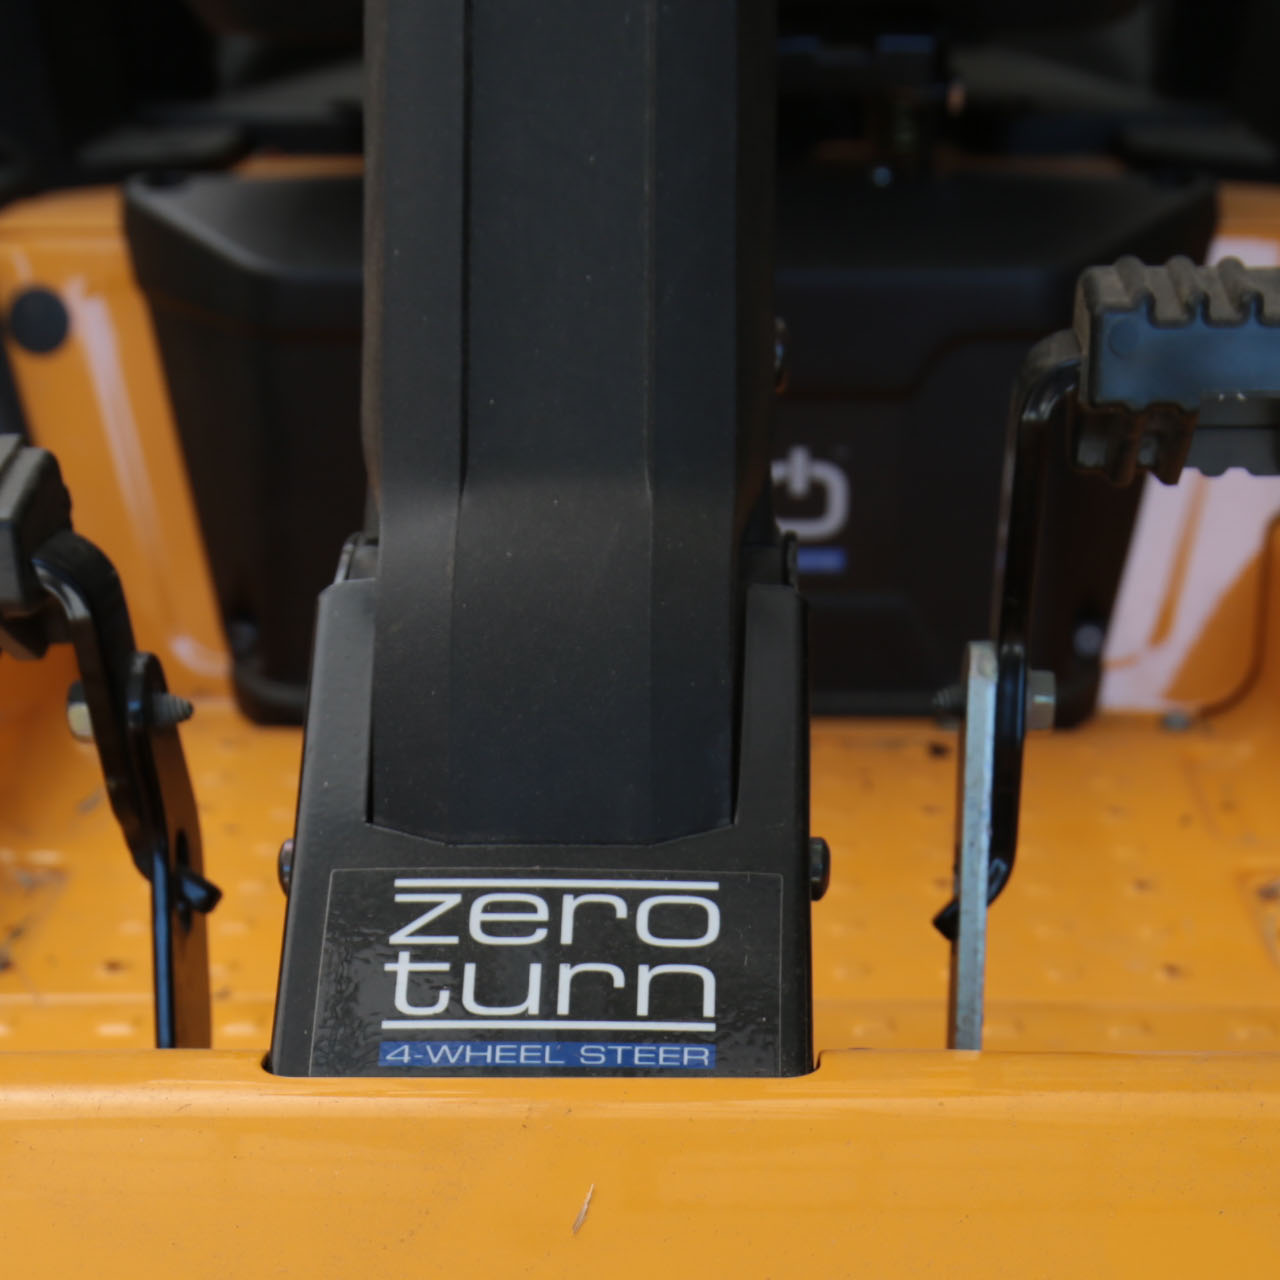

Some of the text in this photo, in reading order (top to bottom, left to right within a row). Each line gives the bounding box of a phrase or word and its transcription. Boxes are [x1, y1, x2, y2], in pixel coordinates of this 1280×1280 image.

[388, 892, 721, 948] zero
[383, 950, 717, 1019] turn
[384, 1043, 711, 1067] 4-WHEEL STEER
